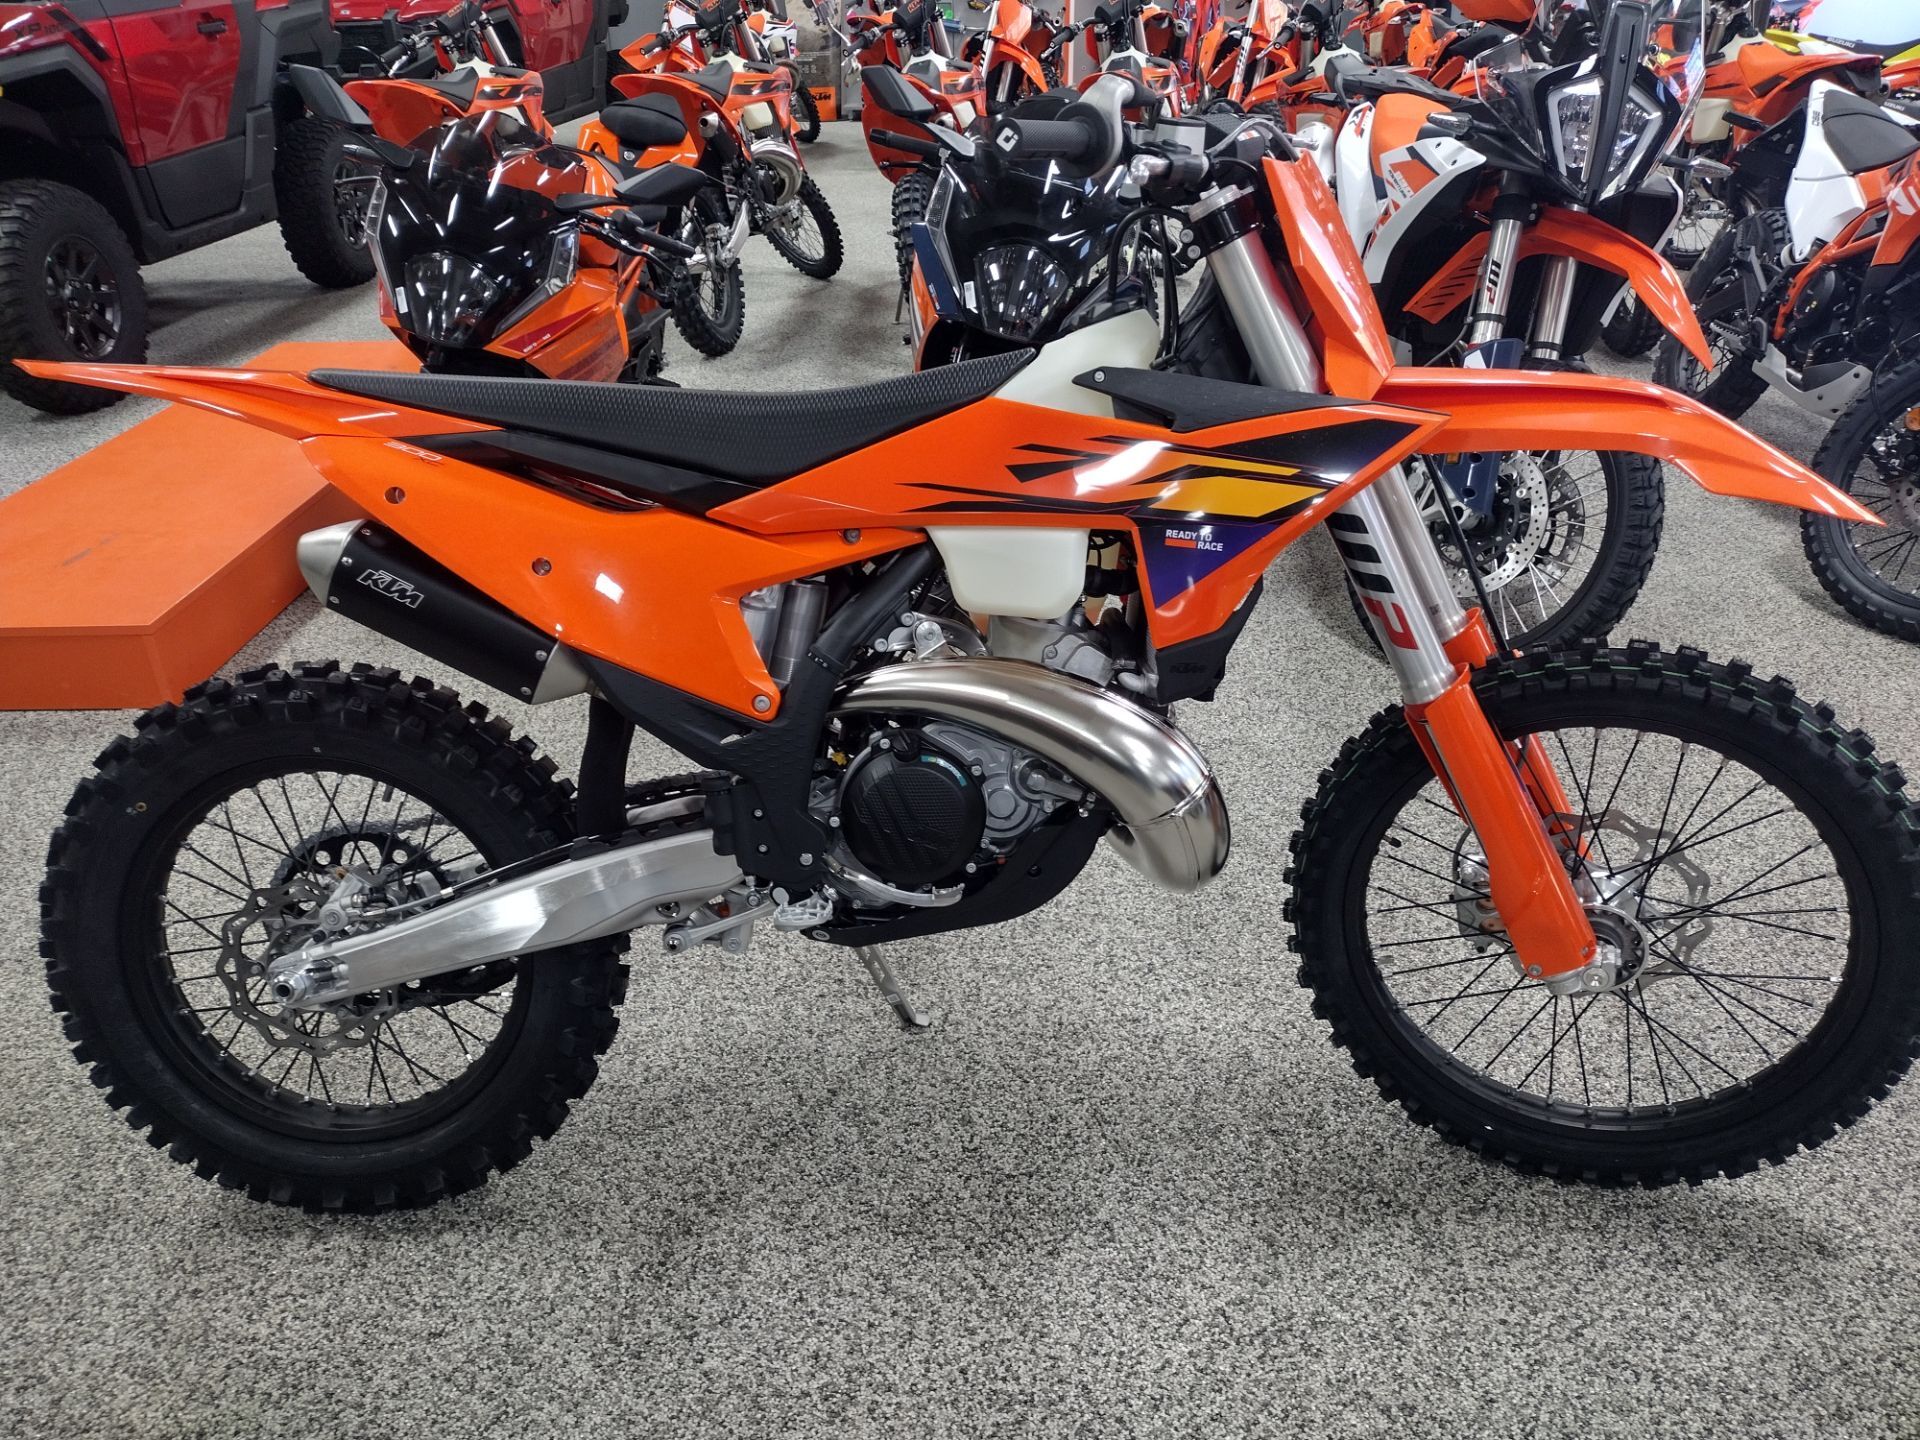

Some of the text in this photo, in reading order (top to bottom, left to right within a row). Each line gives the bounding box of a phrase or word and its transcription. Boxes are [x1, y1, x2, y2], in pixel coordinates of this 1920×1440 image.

[1165, 529, 1198, 540] READY
[1197, 541, 1224, 552] RACE
[356, 568, 425, 609] KTM
